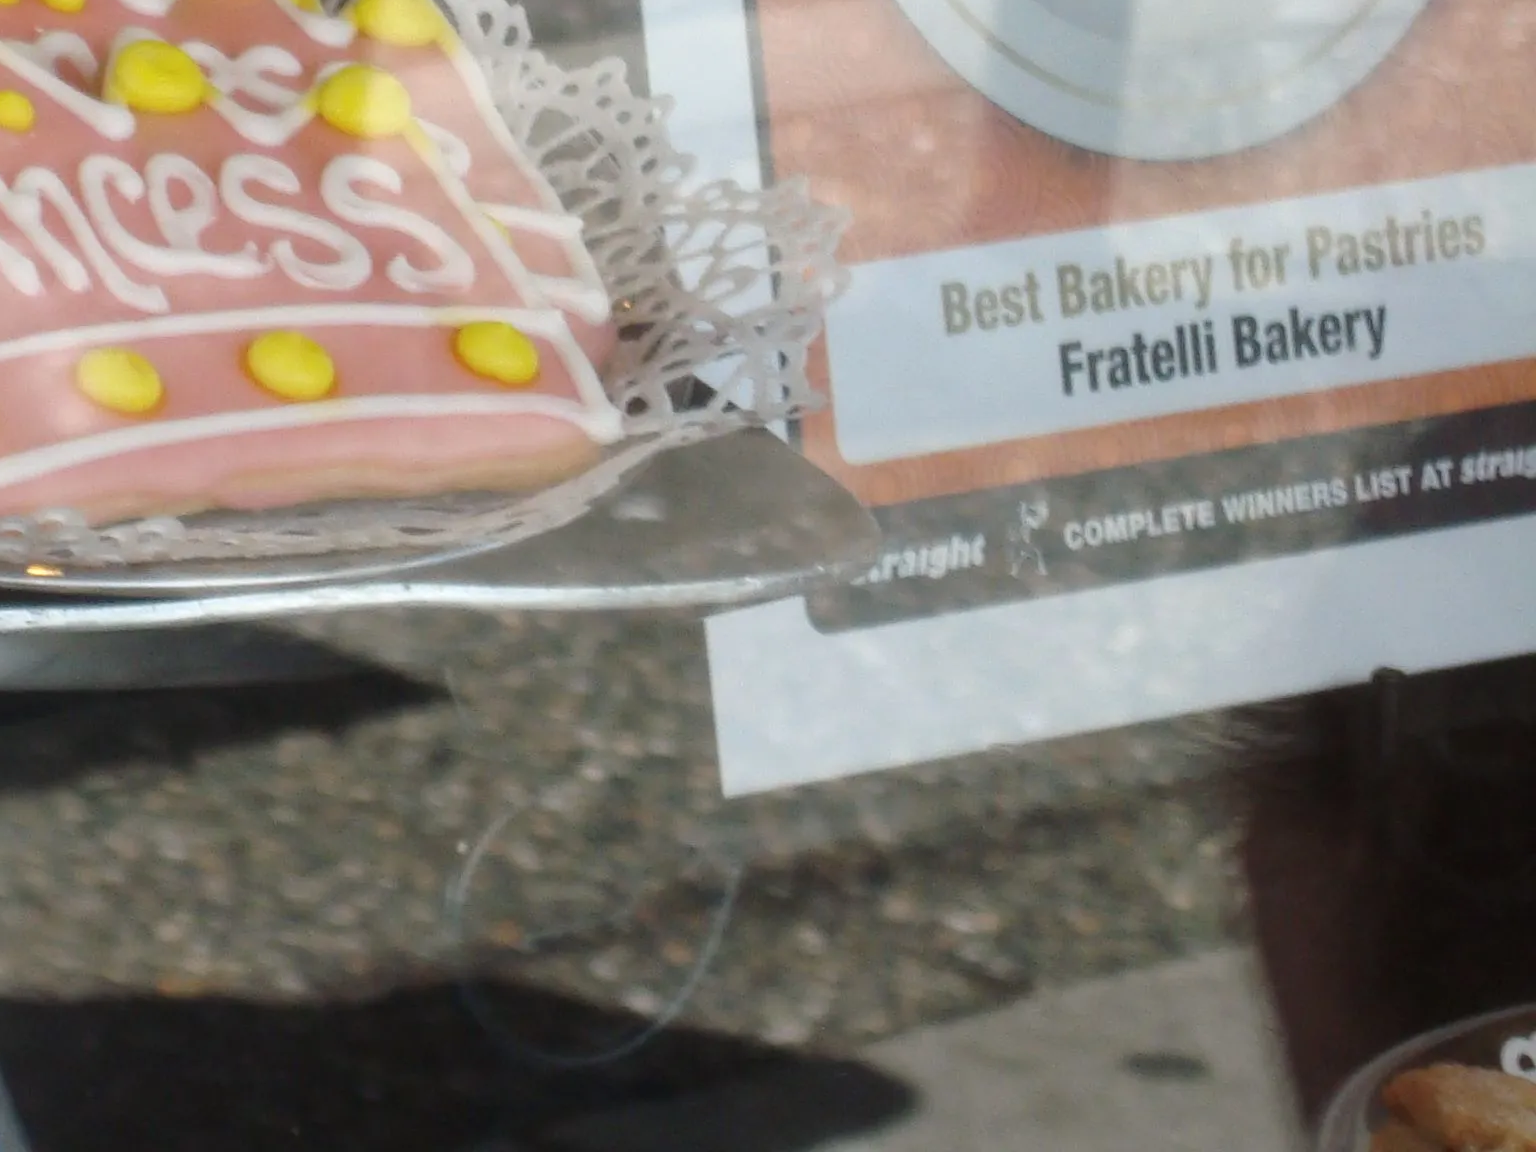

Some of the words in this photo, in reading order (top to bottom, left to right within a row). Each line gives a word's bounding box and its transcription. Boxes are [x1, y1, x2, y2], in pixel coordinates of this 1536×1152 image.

[940, 268, 1045, 336] Best
[1056, 254, 1212, 319] Bakery
[1226, 236, 1290, 291] for
[1306, 209, 1486, 281] Pastries
[1058, 319, 1217, 397] Fratelli
[1231, 304, 1386, 360] Bakery
[1064, 500, 1216, 551] COMPLETE
[1221, 476, 1348, 524] WINNERS
[1353, 465, 1412, 502] LIST
[1420, 456, 1454, 491] AT
